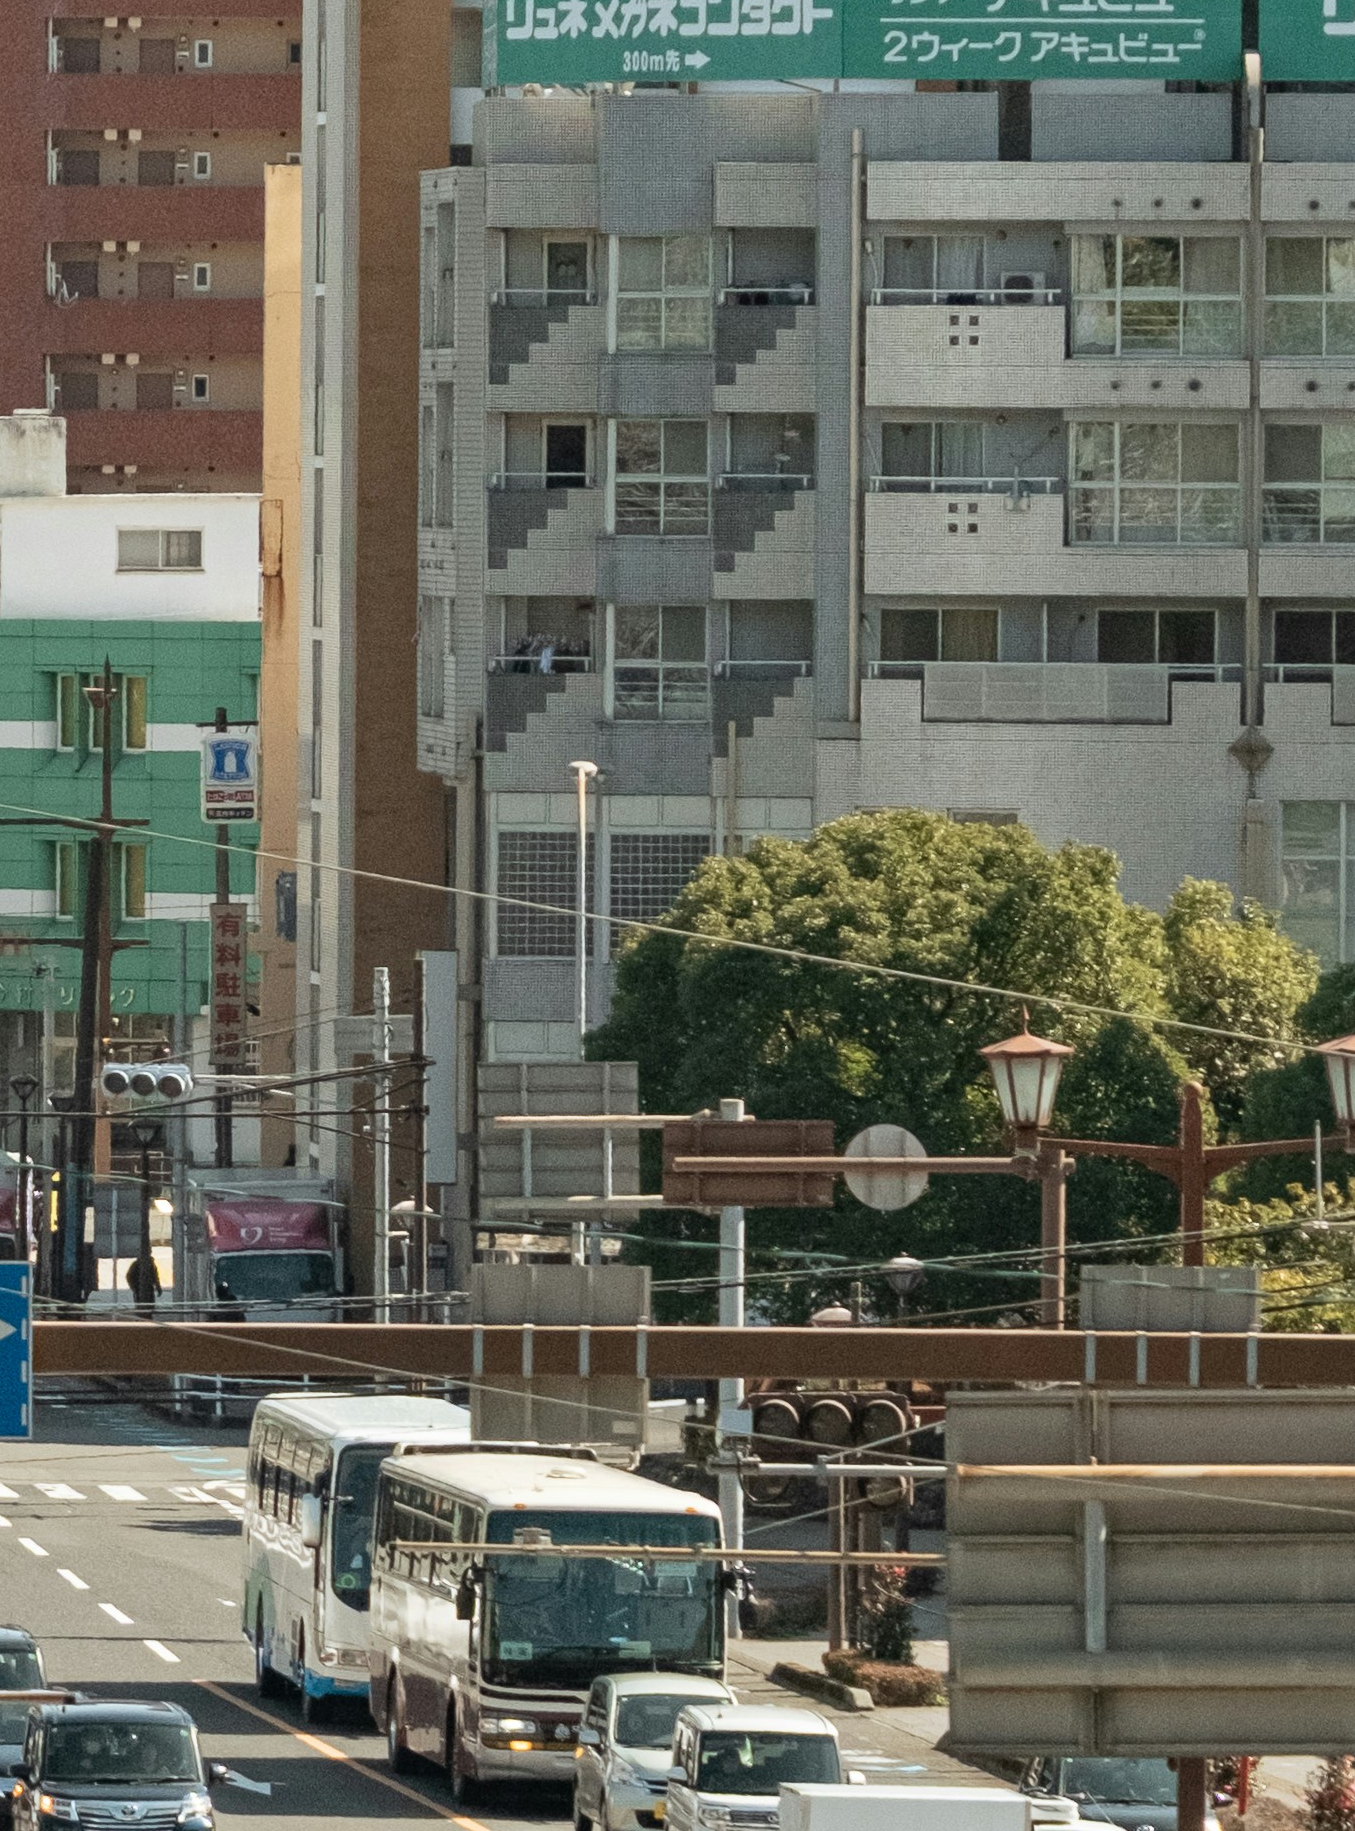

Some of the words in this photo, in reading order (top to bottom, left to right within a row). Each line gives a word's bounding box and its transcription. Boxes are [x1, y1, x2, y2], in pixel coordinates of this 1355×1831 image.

[214, 912, 242, 1057] 有料駐車場
